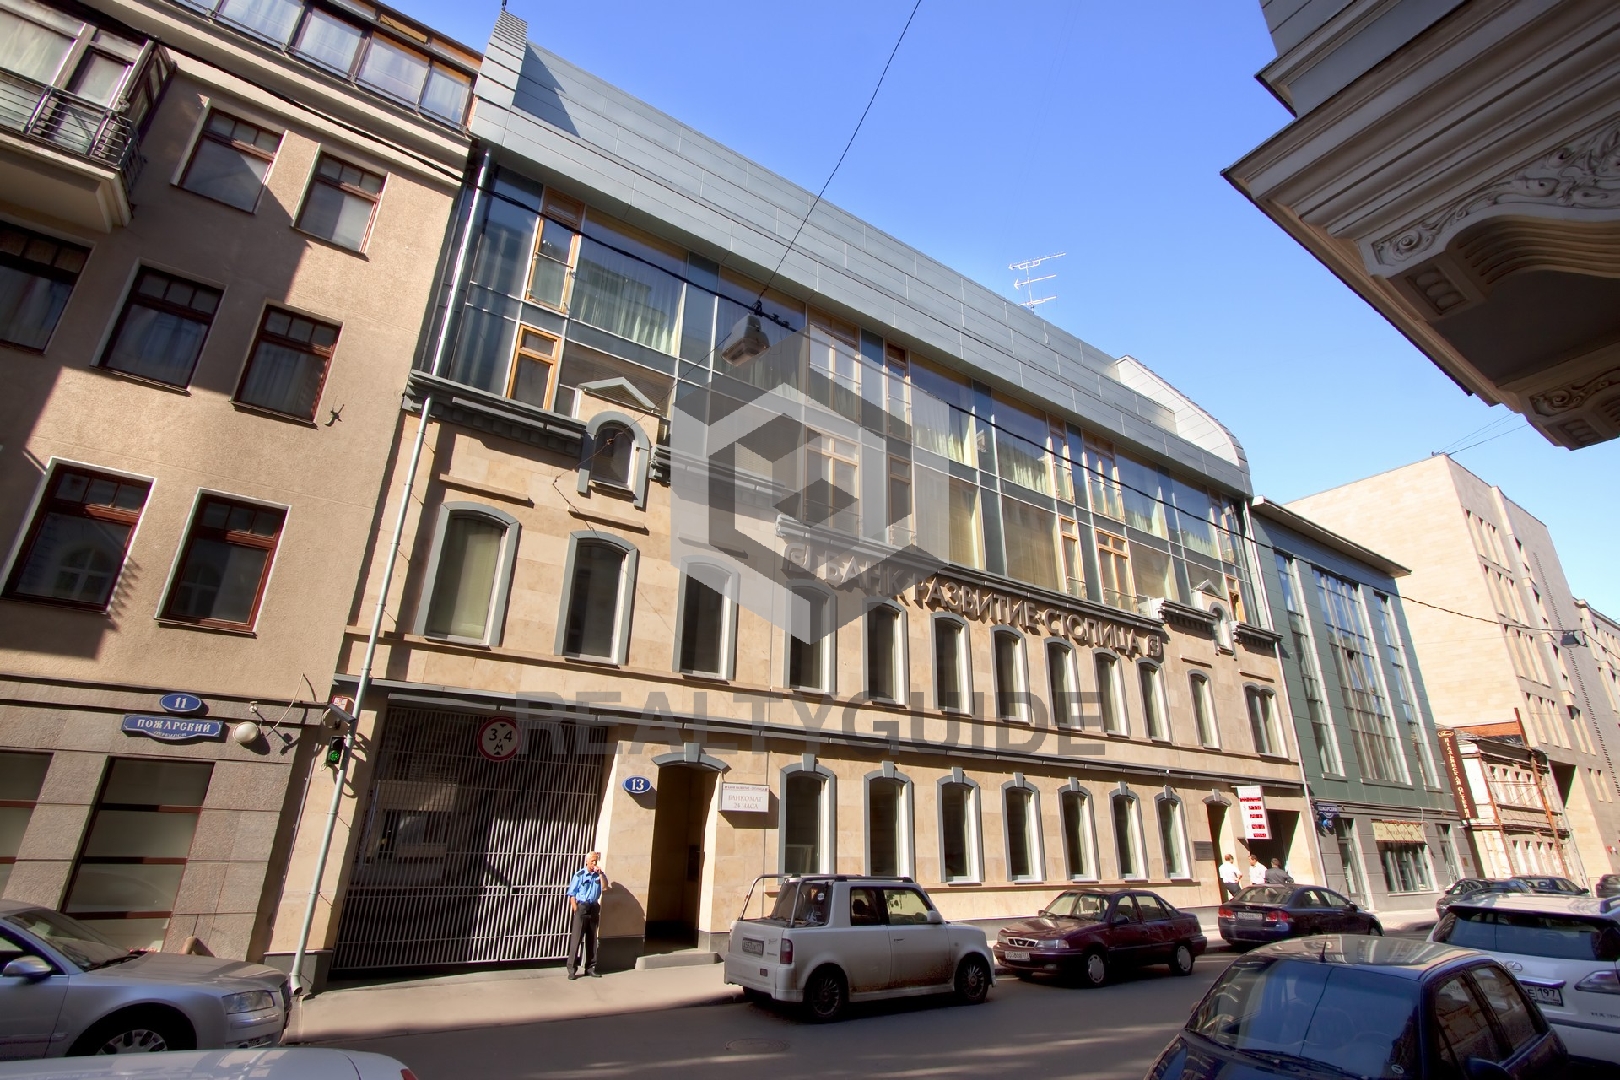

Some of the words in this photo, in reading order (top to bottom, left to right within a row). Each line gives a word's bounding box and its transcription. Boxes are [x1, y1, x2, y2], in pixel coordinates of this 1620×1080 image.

[825, 550, 904, 595] БАНК
[174, 697, 187, 709] 11
[137, 719, 211, 733] ПОЖАРСКИЙ
[631, 779, 645, 791] 13
